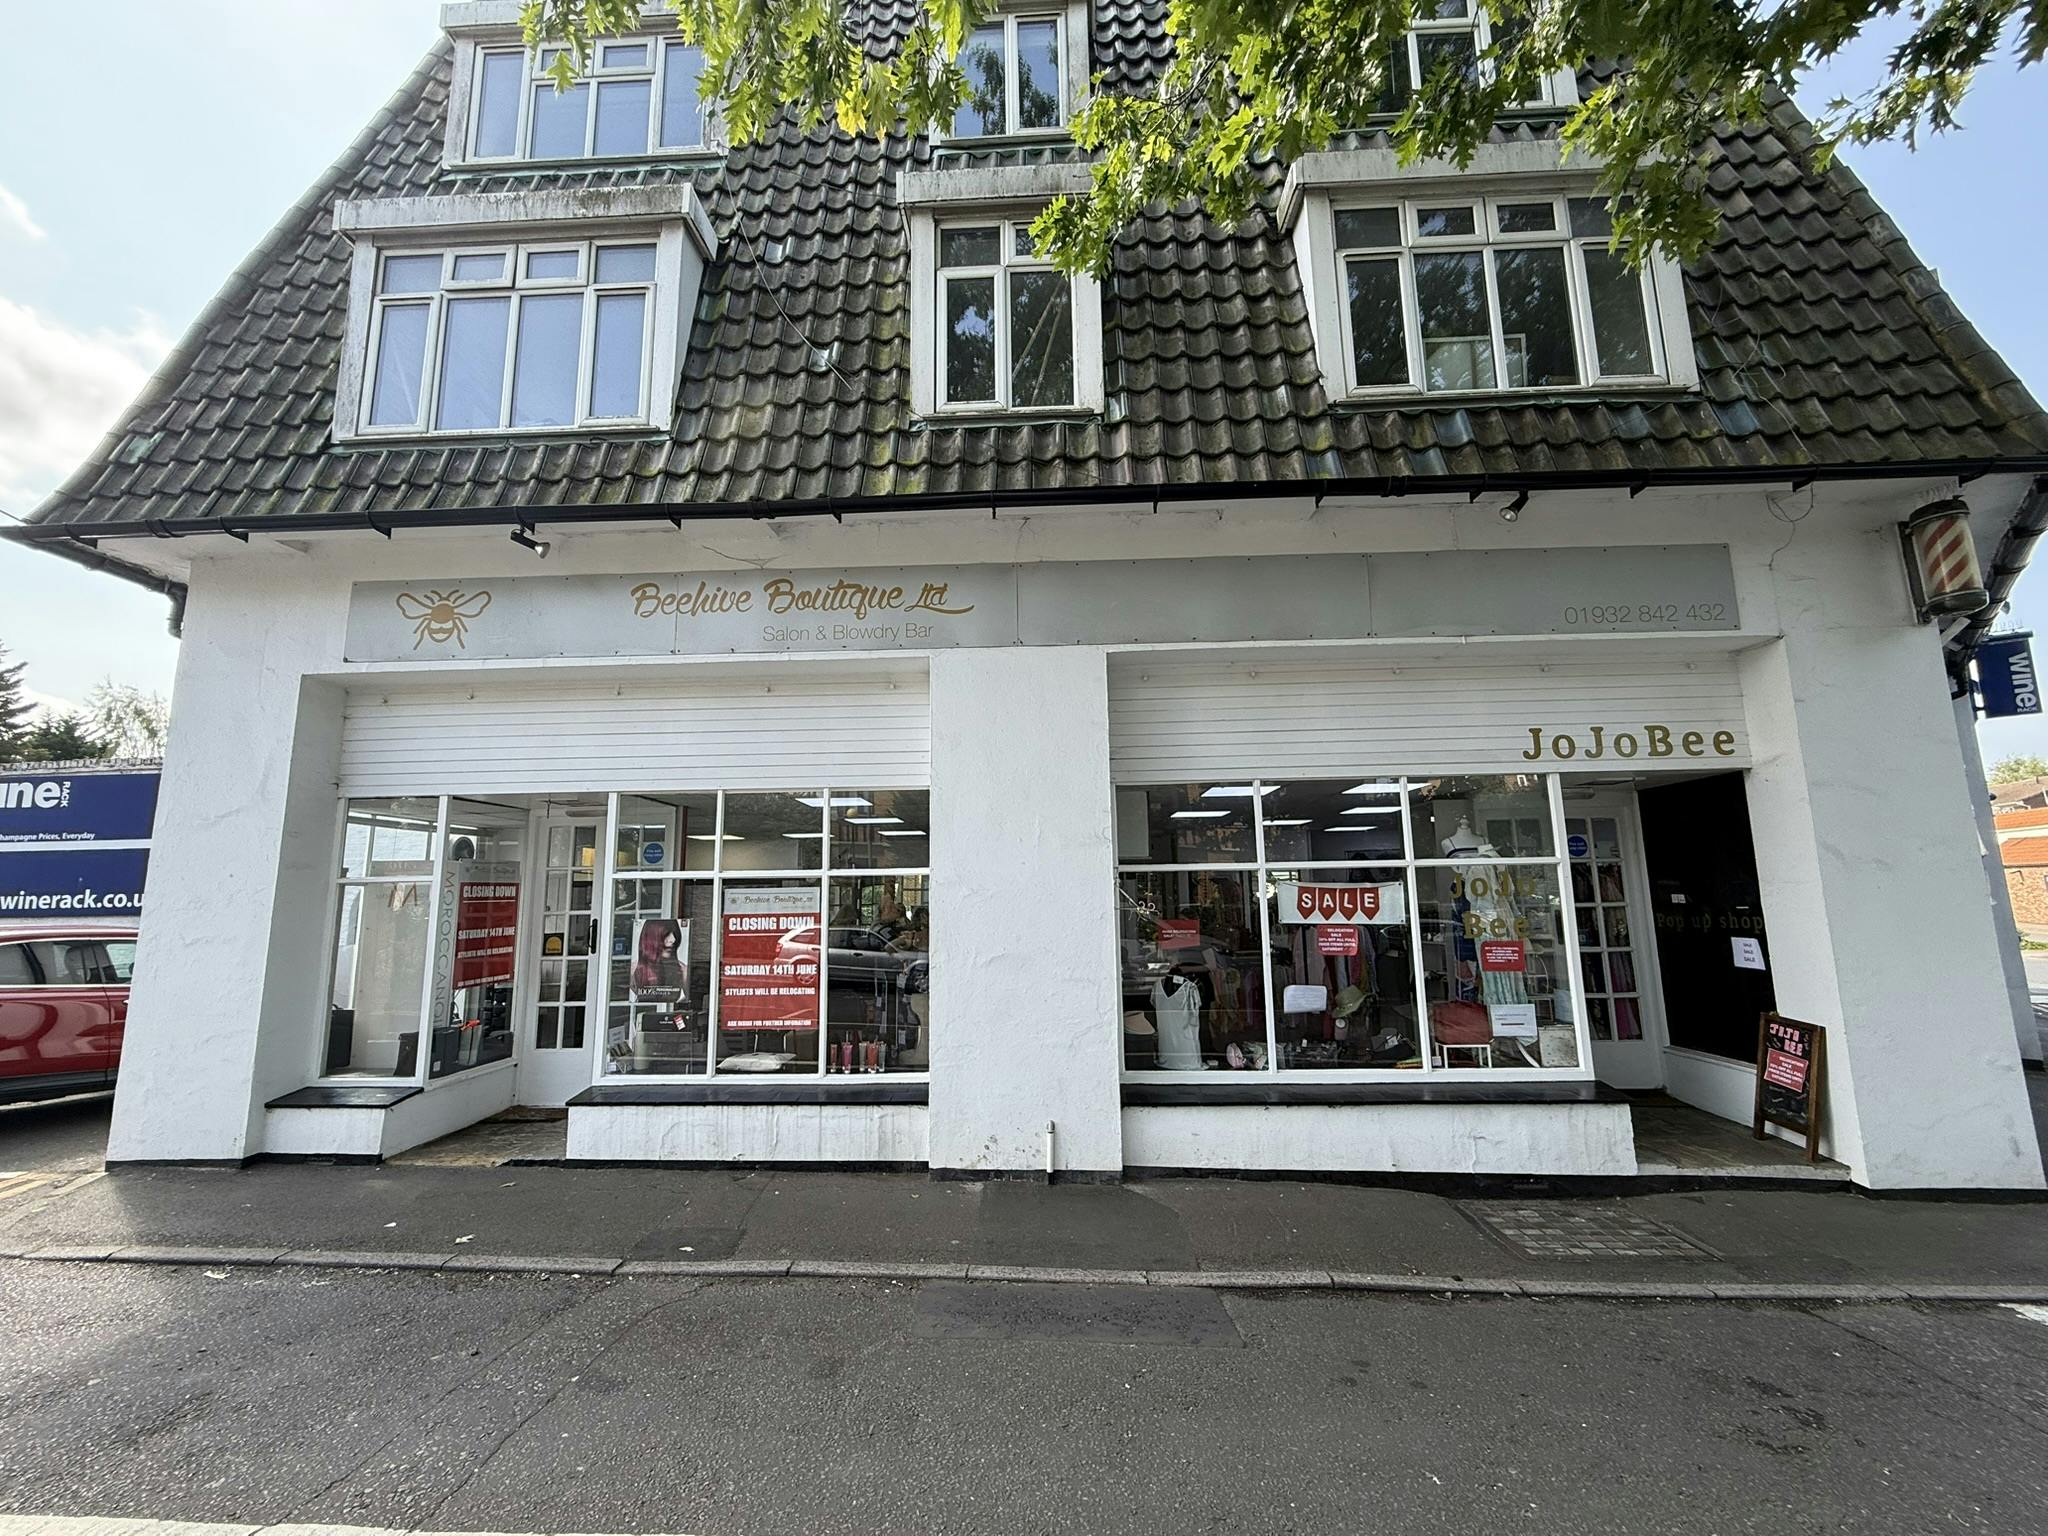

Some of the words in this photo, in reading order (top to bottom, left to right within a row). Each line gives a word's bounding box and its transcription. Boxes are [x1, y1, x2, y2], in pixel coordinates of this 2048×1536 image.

[630, 581, 753, 617] Beehive
[763, 578, 906, 620] Boutique
[904, 582, 976, 615] Ltd
[1564, 605, 1633, 624] 01932
[1638, 604, 1679, 623] 842
[1685, 603, 1726, 621] 432
[763, 625, 810, 642] Salon
[815, 625, 827, 640] &
[833, 623, 901, 643] Blowdry
[904, 622, 934, 639] Bar
[2008, 652, 2037, 707] wine
[1522, 725, 1736, 760] JoJoBee
[60, 781, 71, 808] RACK
[62, 831, 96, 840] Everyday
[463, 885, 495, 898] CLOSING
[495, 885, 517, 898] DOWN
[1301, 892, 1376, 909] SALE
[728, 917, 777, 931] CLOSING
[779, 916, 815, 930] DOWN
[1462, 911, 1529, 938] Bee
[1656, 912, 1684, 932] Pop
[1692, 913, 1712, 933] up
[1720, 912, 1763, 934] shop
[724, 965, 771, 976] SATURDAY
[772, 964, 795, 975] 14TH
[795, 964, 817, 975] JUNE
[725, 988, 753, 996] STYLISTS
[780, 987, 816, 995] RELOCATING
